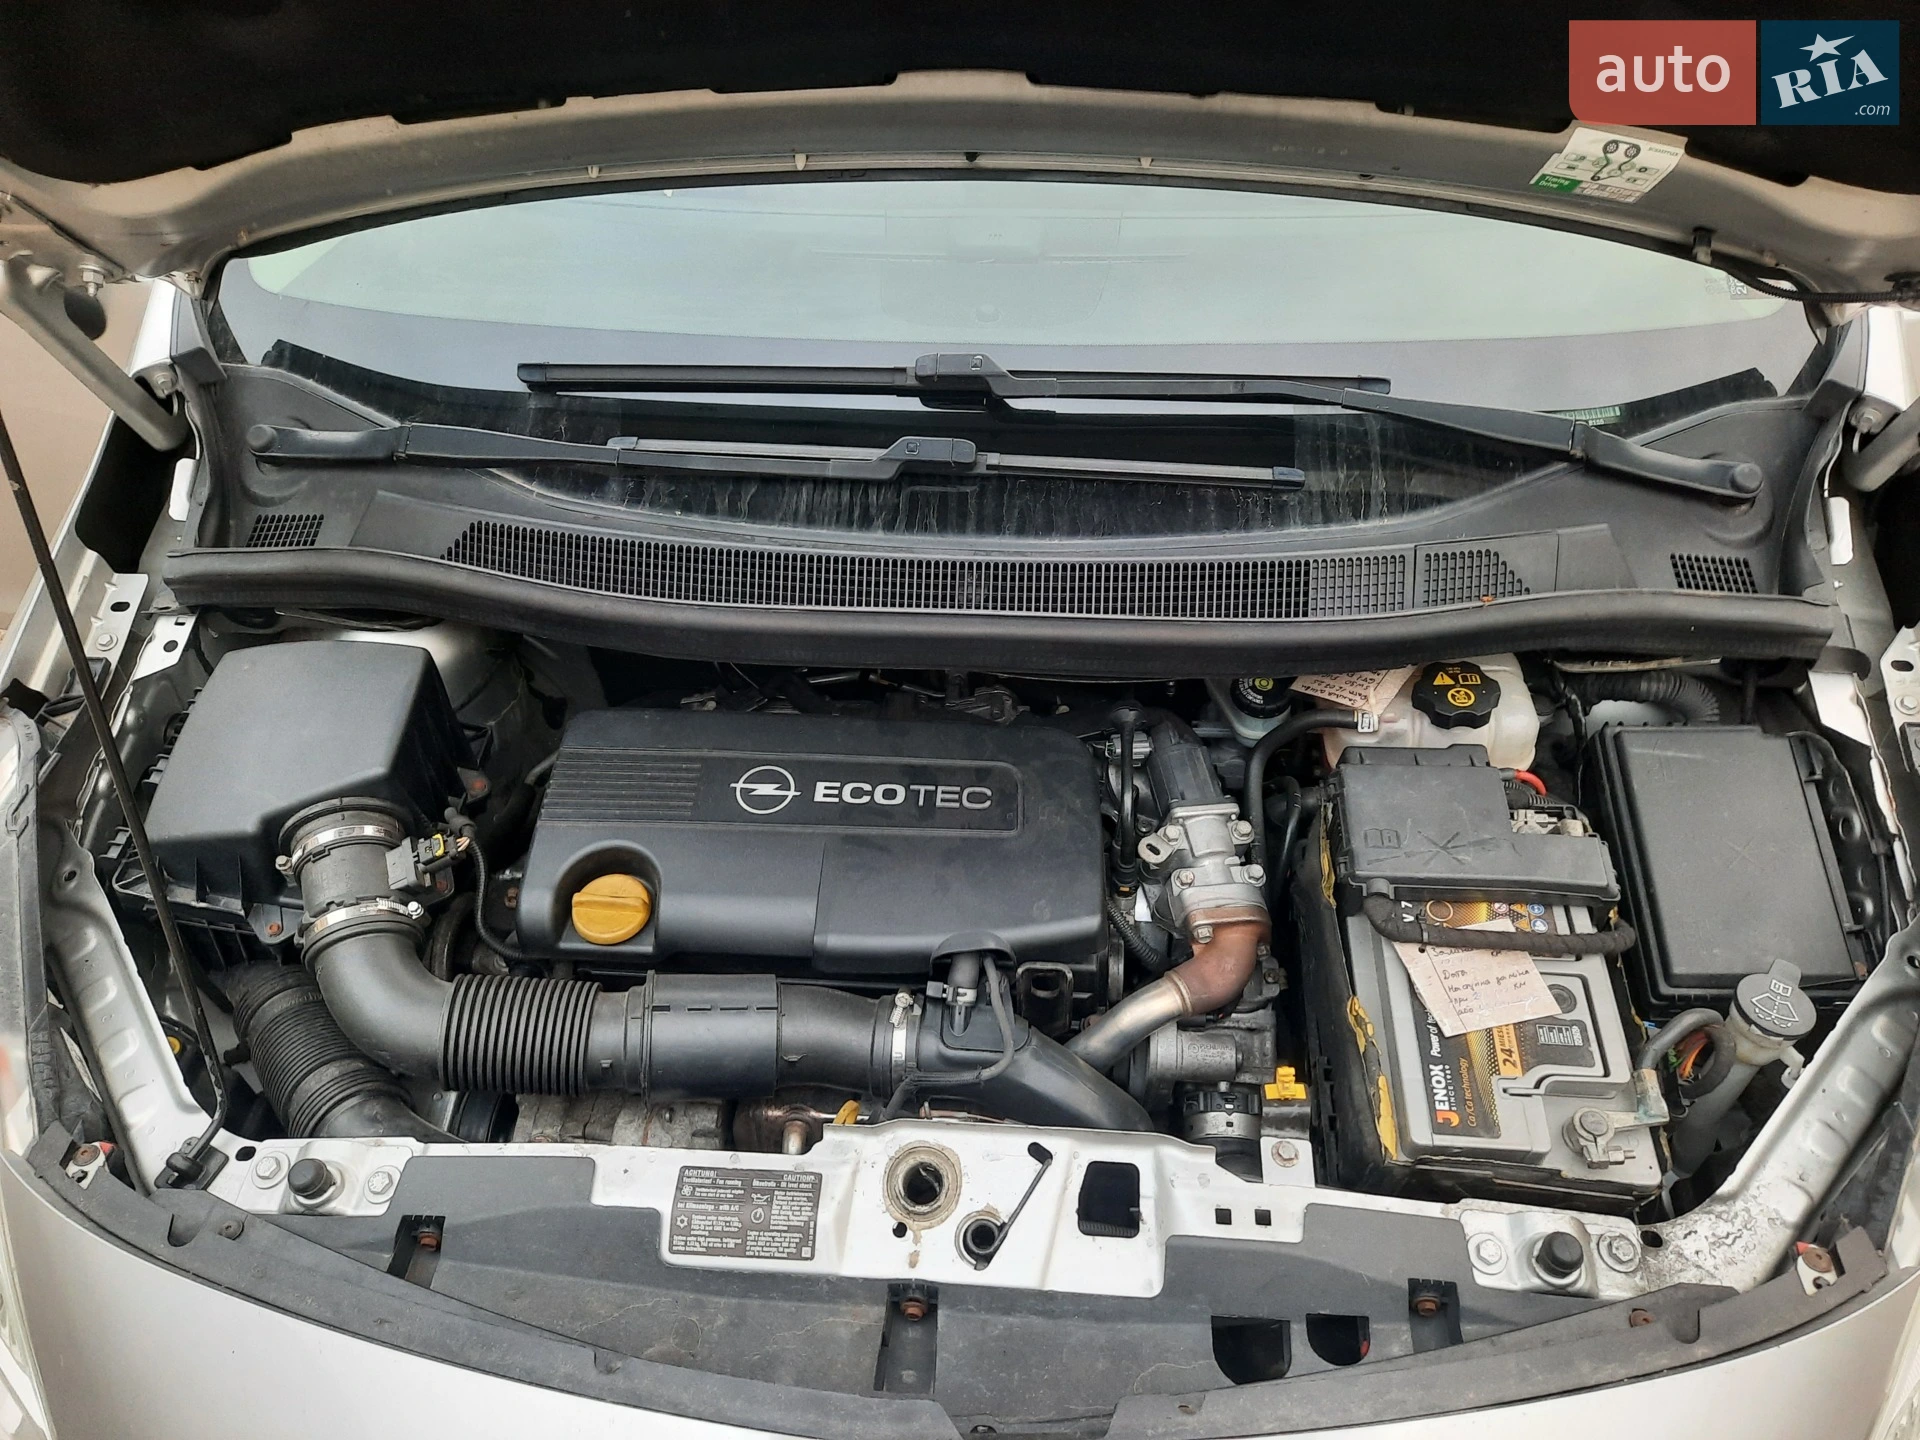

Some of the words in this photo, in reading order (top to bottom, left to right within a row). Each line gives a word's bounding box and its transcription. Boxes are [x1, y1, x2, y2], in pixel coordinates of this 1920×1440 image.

[1538, 180, 1559, 188] Drive
[1544, 176, 1571, 186] Timing
[813, 781, 993, 810] ECOTEC
[1426, 1025, 1438, 1034] of
[1430, 1034, 1442, 1058] Power
[1500, 1046, 1518, 1070] 24
[1444, 1064, 1452, 1083] 1989
[1460, 1057, 1472, 1102] technology
[1429, 1064, 1460, 1128] JENOX
[1446, 1085, 1457, 1110] SINCE
